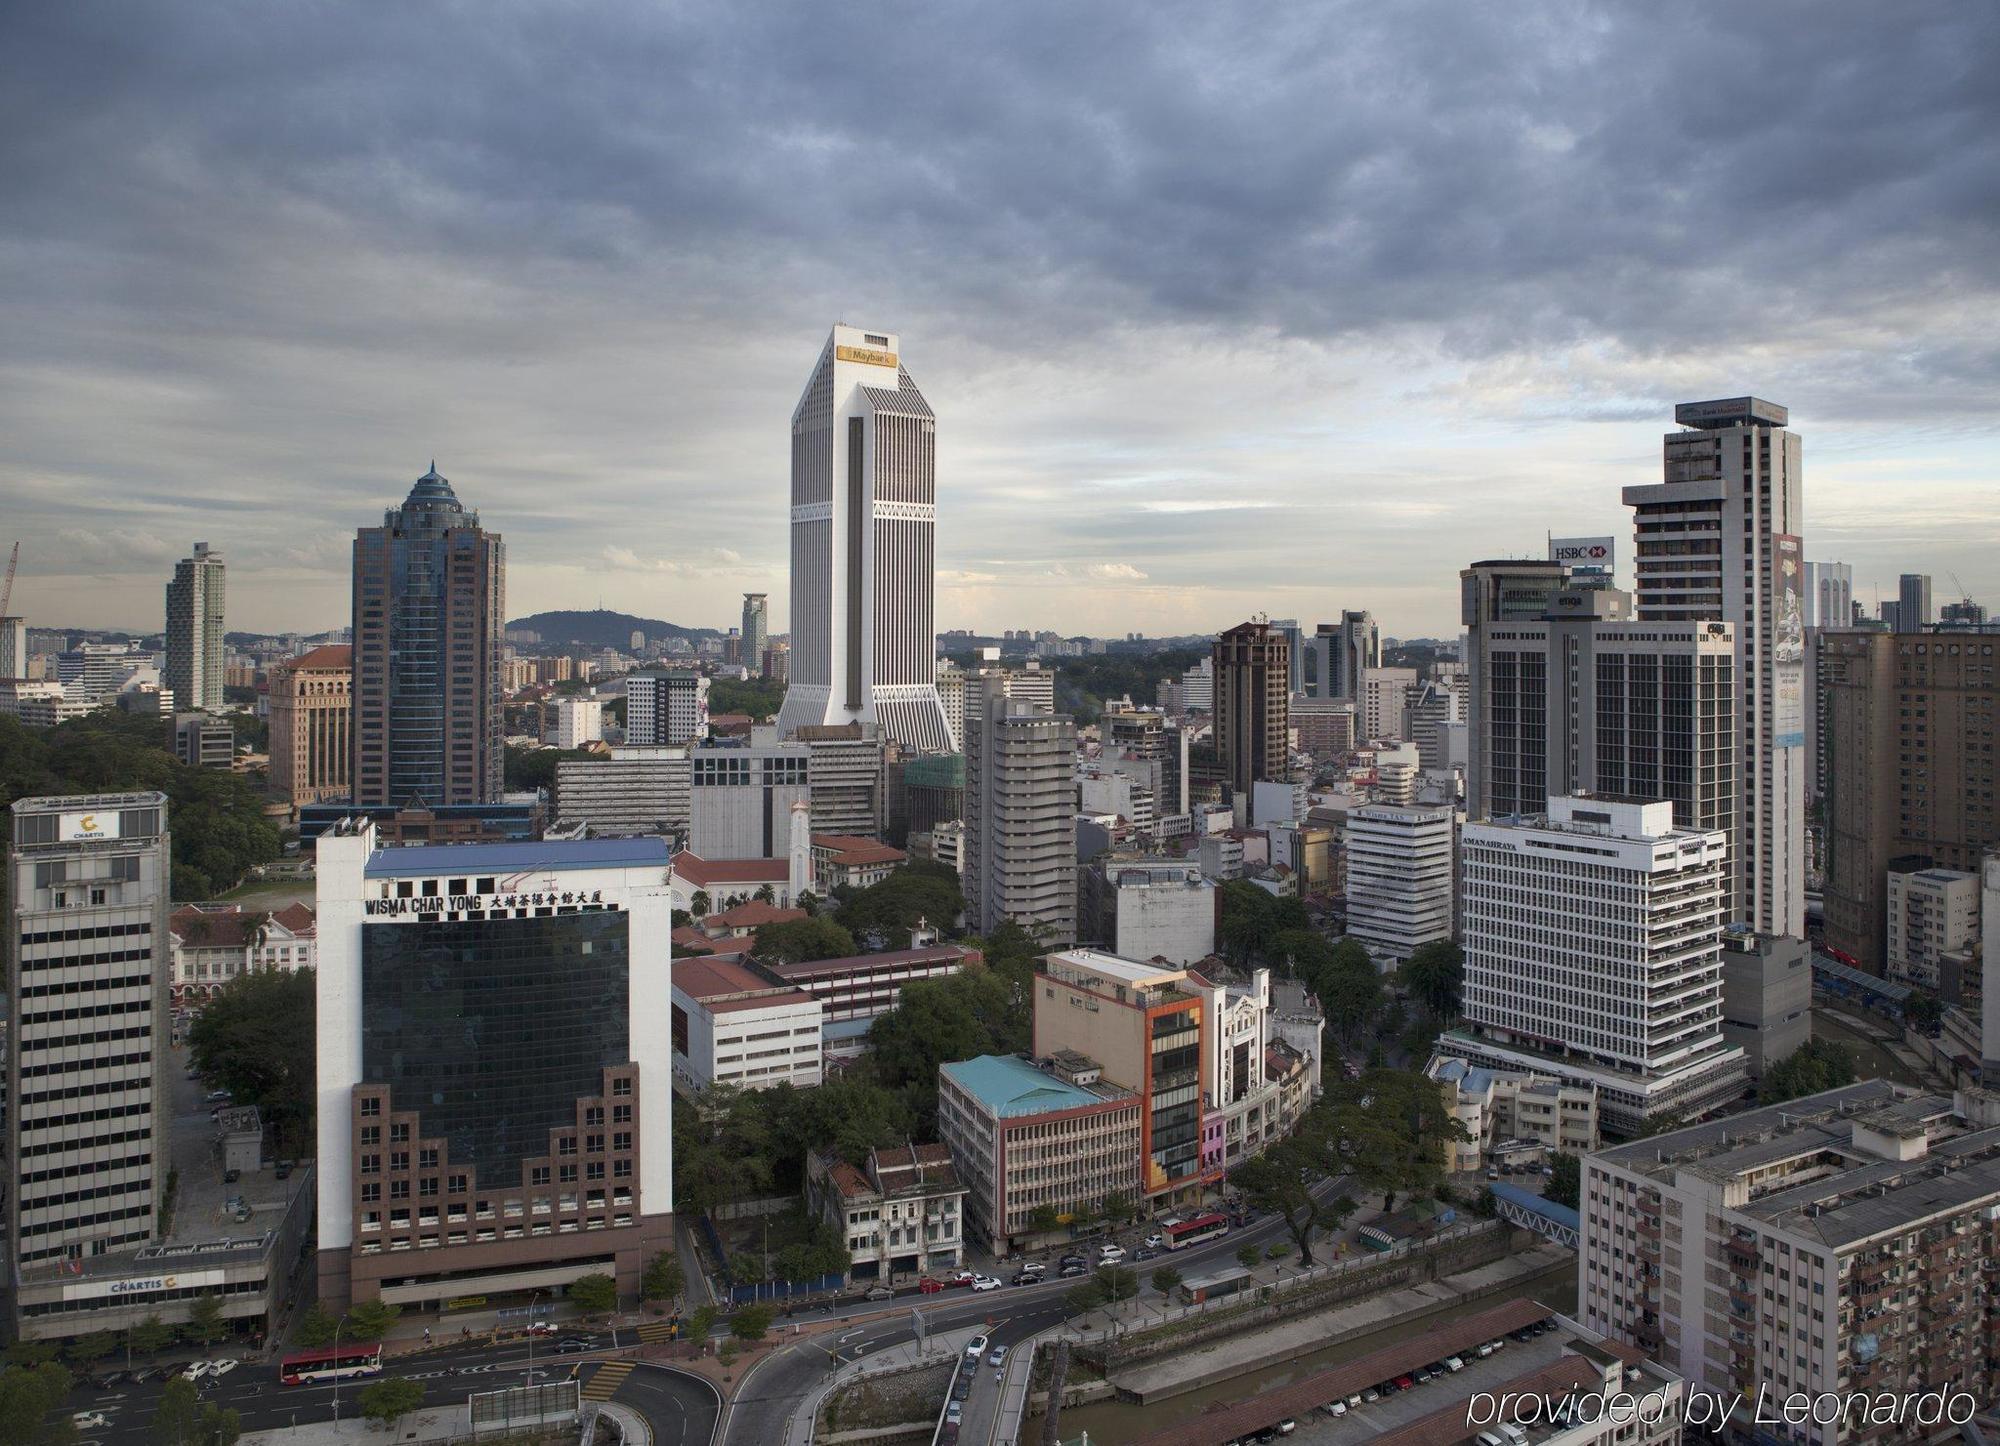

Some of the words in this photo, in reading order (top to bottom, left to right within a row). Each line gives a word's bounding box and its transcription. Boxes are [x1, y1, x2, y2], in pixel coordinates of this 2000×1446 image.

[853, 350, 890, 363] Maybank
[1556, 547, 1587, 559] HSBC
[1463, 838, 1517, 851] AMANAHRAYA
[366, 899, 407, 915] WISMA
[411, 898, 444, 913] CHAR
[449, 896, 481, 910] YONG
[111, 1279, 162, 1293] CHARTIS
